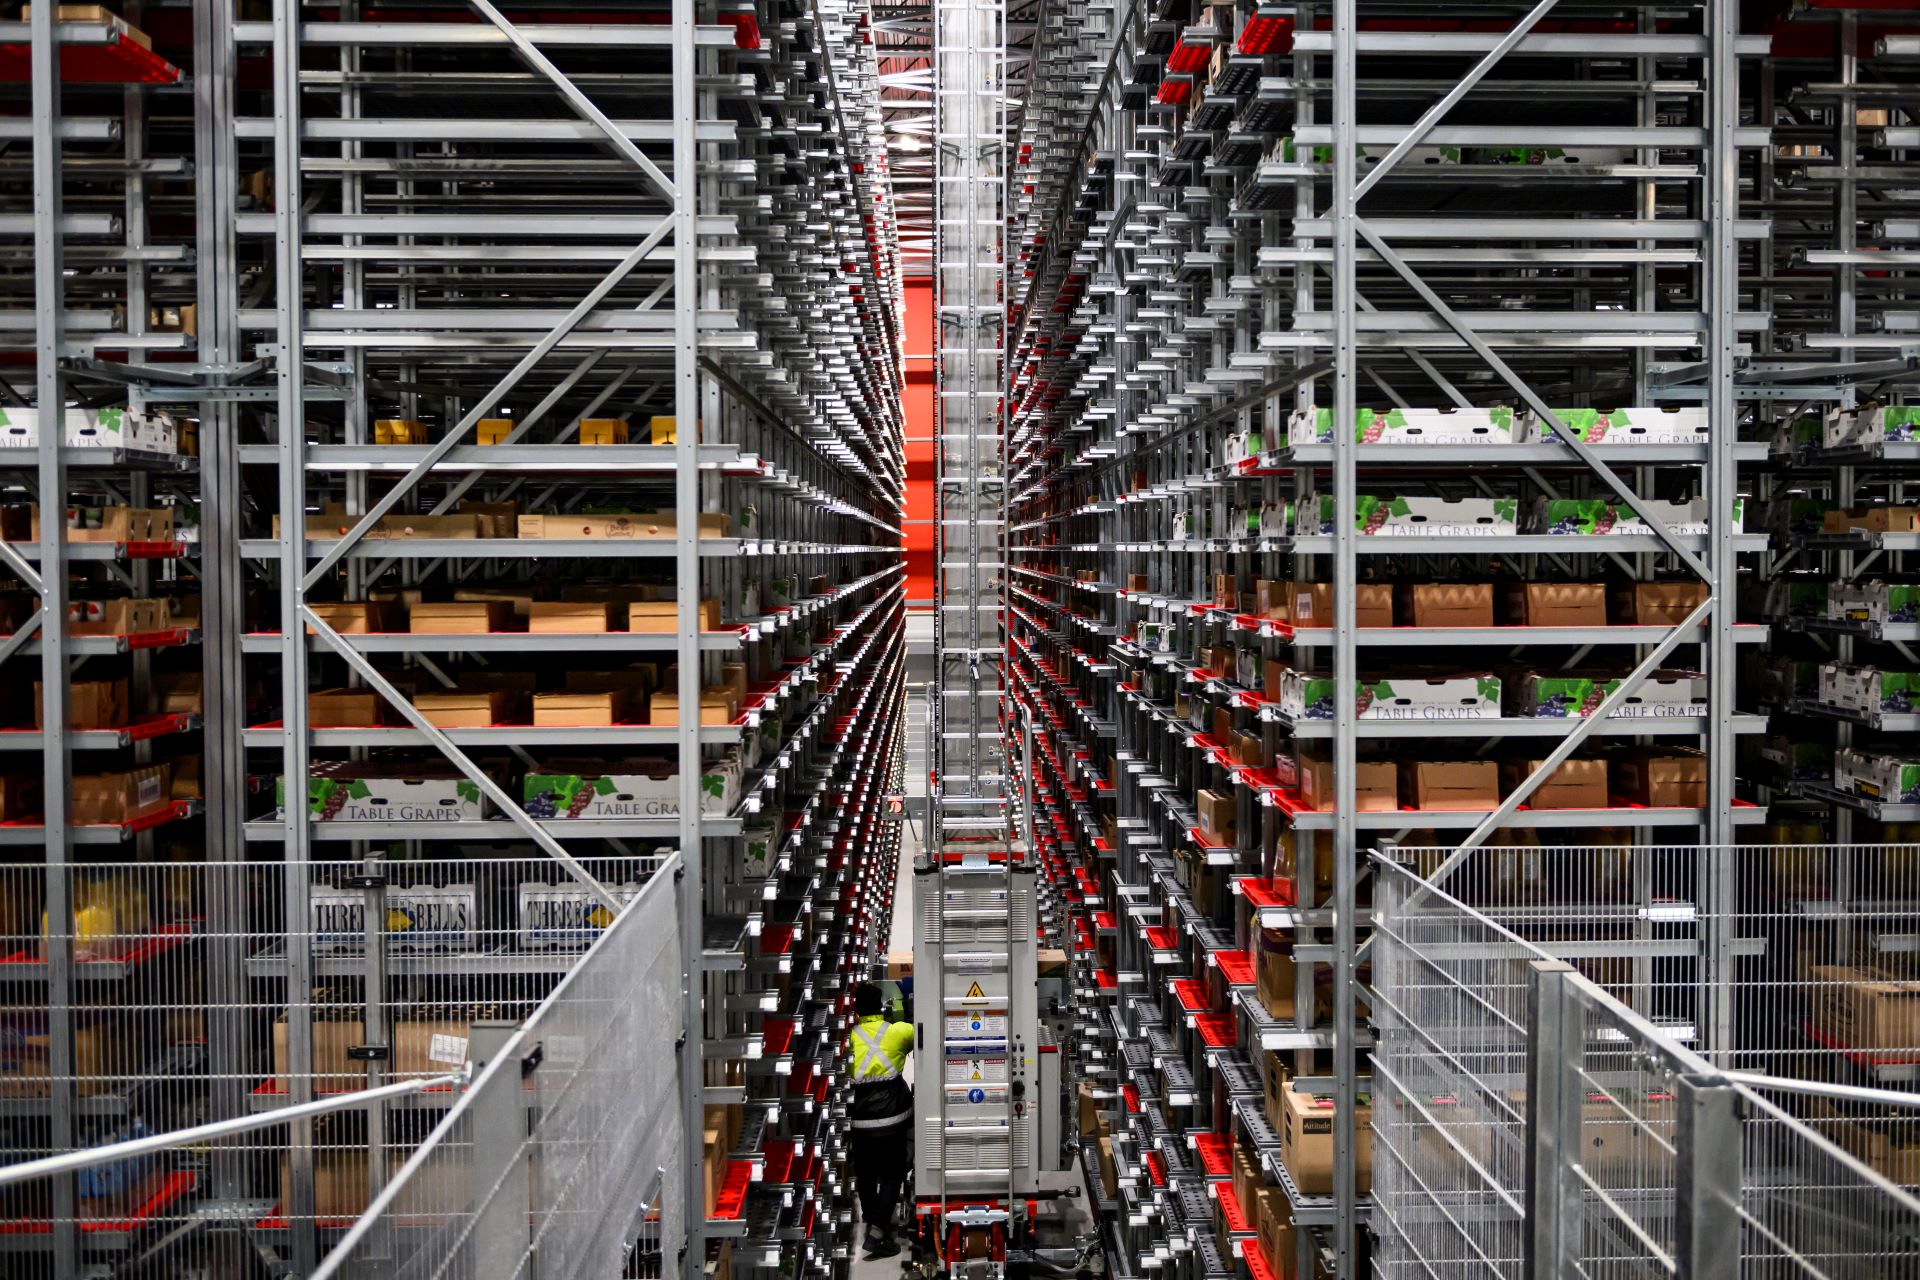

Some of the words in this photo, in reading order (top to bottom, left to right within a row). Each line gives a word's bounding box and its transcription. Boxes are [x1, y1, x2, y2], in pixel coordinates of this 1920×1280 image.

[1389, 523, 1434, 536] TABLE
[1439, 524, 1497, 536] GRAPES
[1373, 706, 1417, 719] TABLE
[1423, 705, 1481, 719] GRAPES
[1614, 706, 1648, 717] ABLE
[348, 805, 394, 820] TABLE
[400, 806, 461, 820] GRAPES
[594, 801, 640, 815] TABLE
[646, 801, 706, 815] GRAS
[416, 903, 466, 930] BELLS
